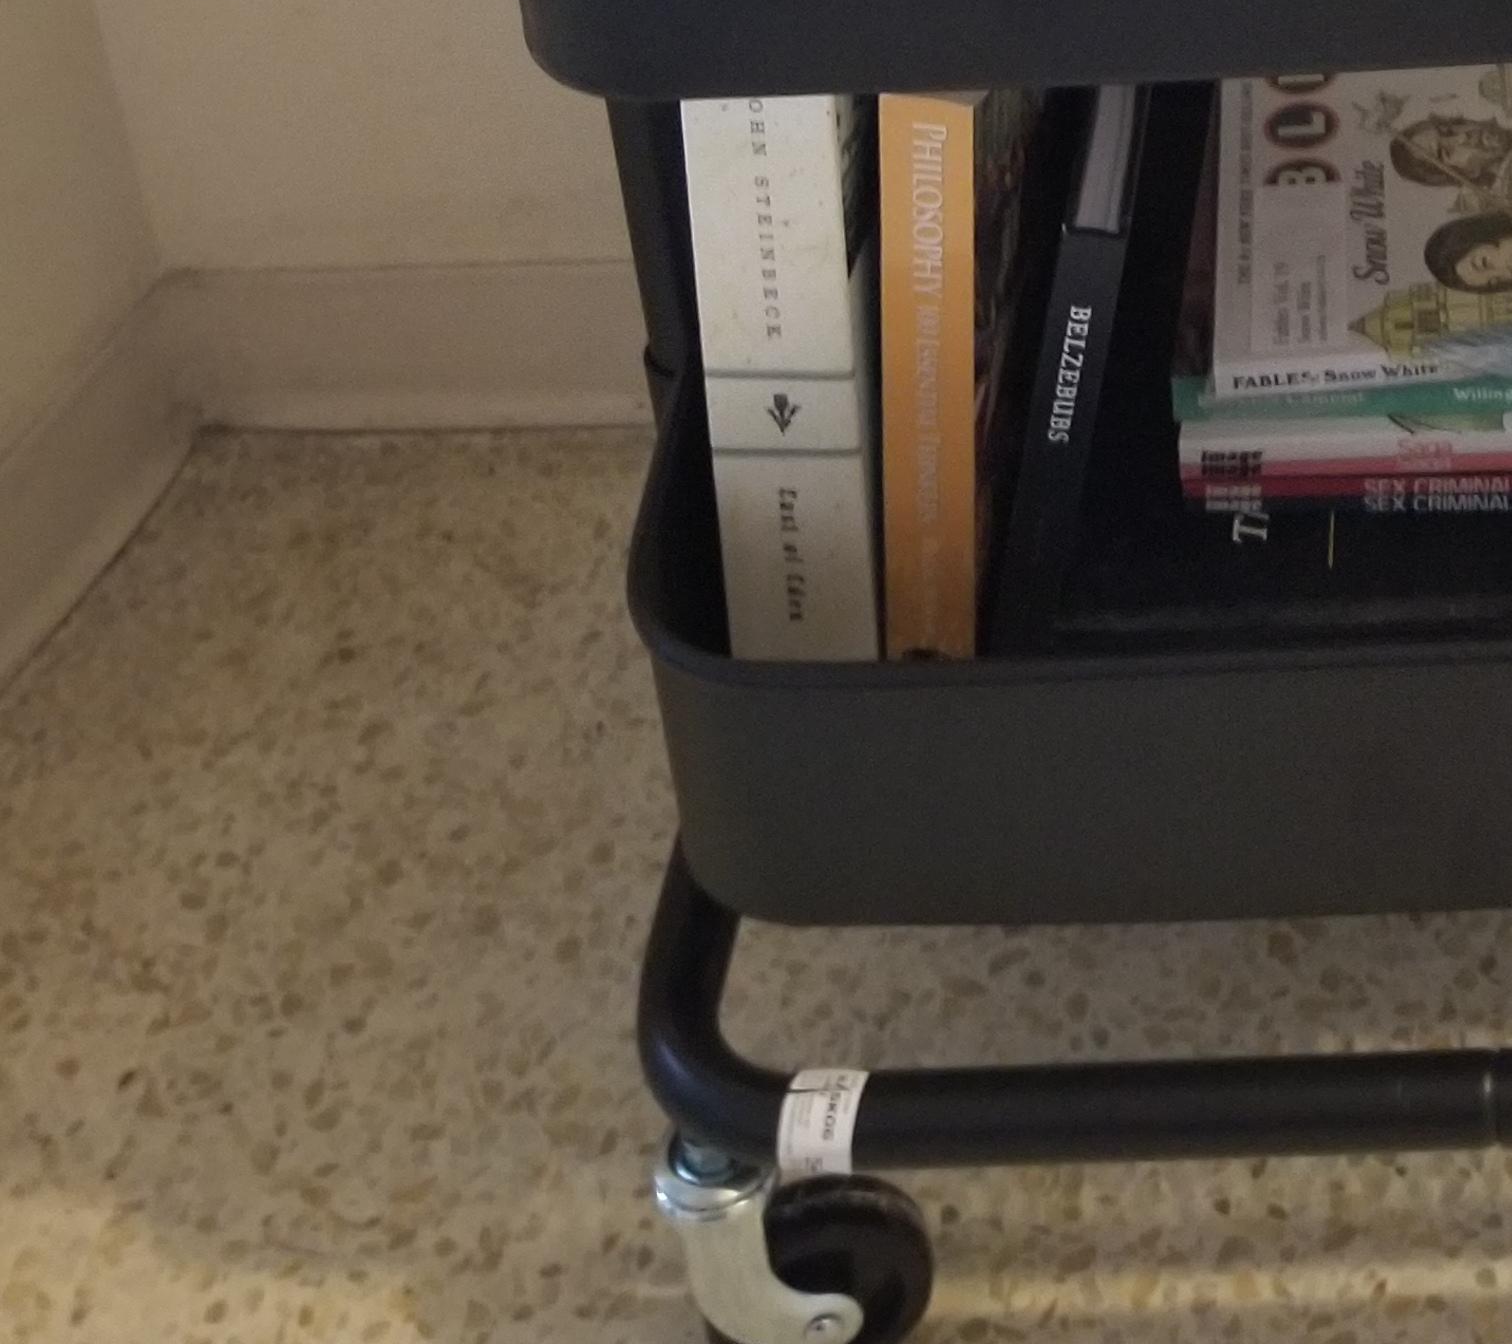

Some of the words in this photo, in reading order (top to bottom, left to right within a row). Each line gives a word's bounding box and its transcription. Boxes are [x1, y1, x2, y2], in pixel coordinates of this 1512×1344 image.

[753, 174, 783, 339] STEINBECK
[911, 121, 949, 299] PHILOSOPHY
[1047, 304, 1093, 444] BELZEBUBS
[1322, 367, 1378, 384] Snow
[1380, 362, 1440, 381] White
[1362, 494, 1406, 511] SEX
